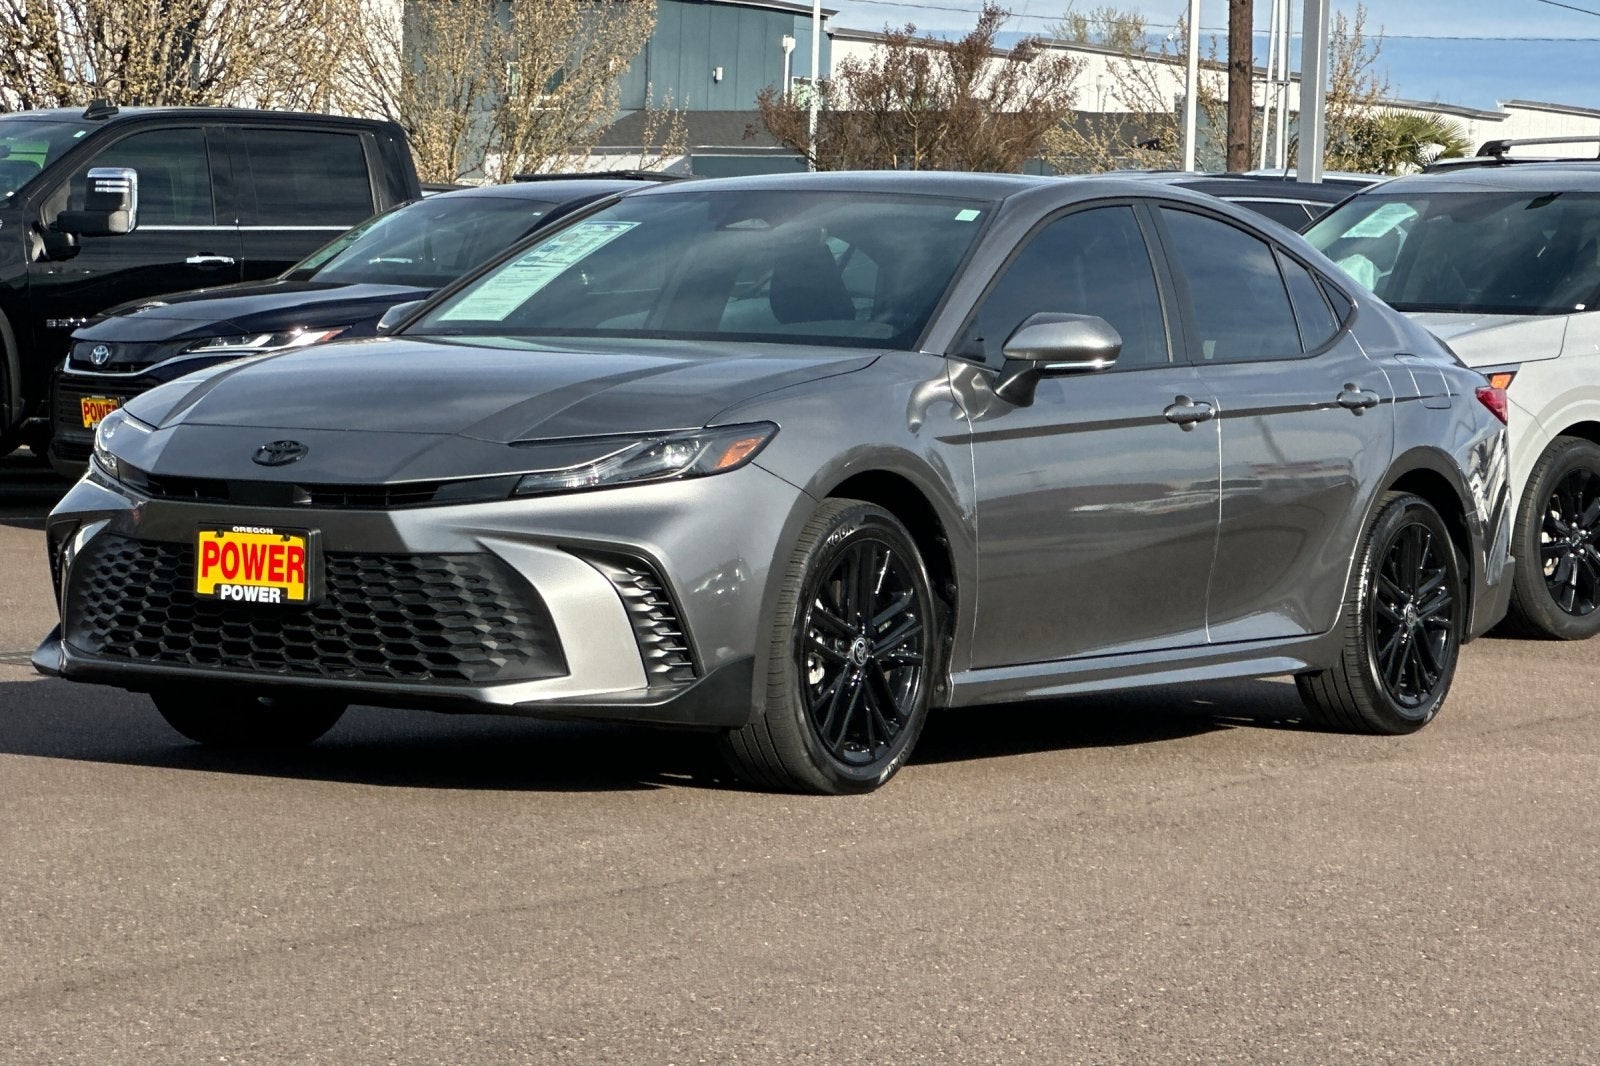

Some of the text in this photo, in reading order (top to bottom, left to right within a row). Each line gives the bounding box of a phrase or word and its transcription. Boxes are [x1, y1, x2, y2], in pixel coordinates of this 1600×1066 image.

[232, 526, 274, 535] OREGON
[202, 541, 305, 584] POWER
[220, 584, 281, 604] POWER
